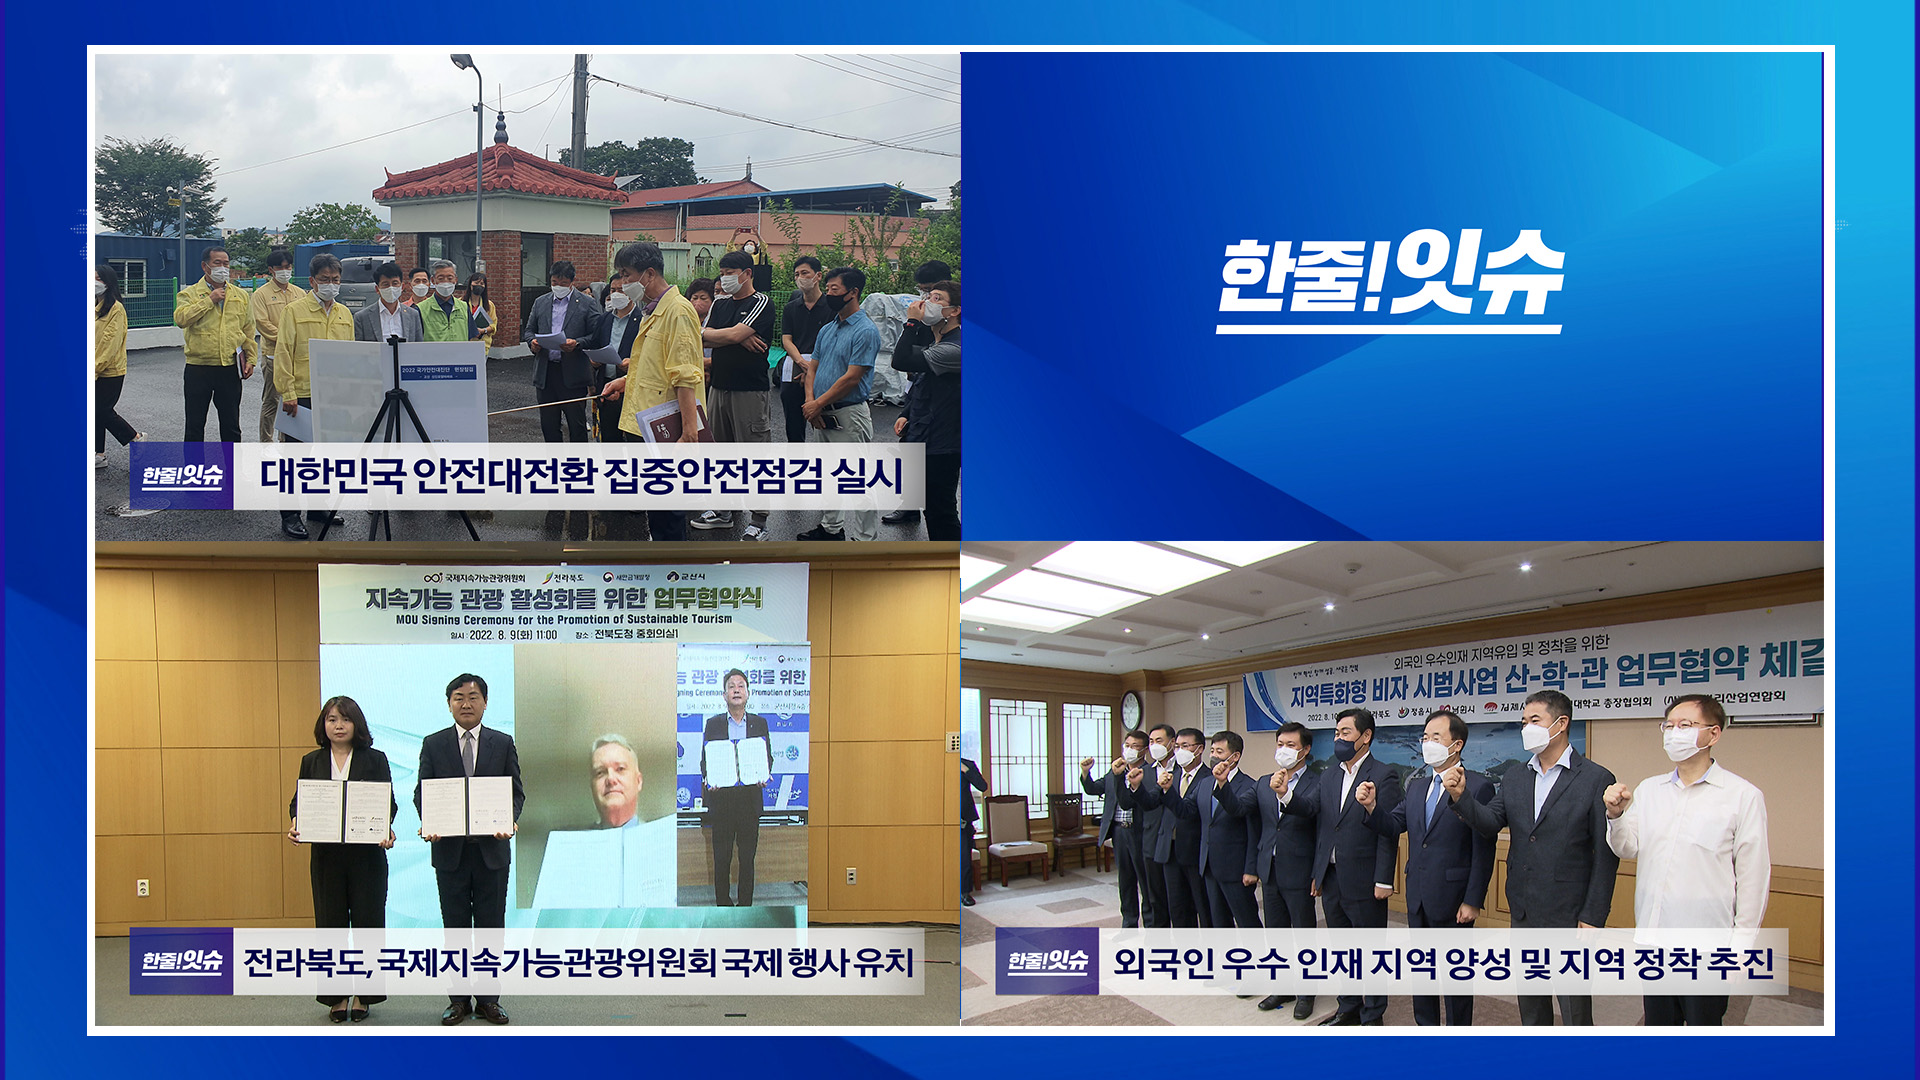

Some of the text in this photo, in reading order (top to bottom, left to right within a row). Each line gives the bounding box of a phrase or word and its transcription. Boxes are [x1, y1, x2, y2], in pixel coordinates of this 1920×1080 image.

[553, 573, 585, 583] 전라북도
[681, 573, 706, 581] 군산시
[366, 587, 763, 611] 지속가능 관광 활성화를 위한 업무협약식
[396, 613, 733, 626] MOU Signing Ceremony for the Promotion of Sustainable Tourism
[536, 630, 558, 640] 11:00
[594, 629, 634, 640] 전북도청
[636, 629, 679, 639] 중회의실1
[1394, 634, 1611, 670] 외국인 우수인재 지역유입 및 정착을 위한
[691, 669, 719, 685] 관광
[780, 669, 806, 685] 위한
[1291, 679, 1367, 708] 지역특화형
[1372, 675, 1409, 702] 비자
[1413, 666, 1498, 699] 시범사업
[1505, 656, 1609, 694] 산-학-관
[1616, 645, 1749, 687] 업무협약
[695, 688, 725, 696] Ceremon
[1713, 690, 1787, 704] 리산업연합회
[1603, 697, 1652, 709] 총장협의회
[1370, 710, 1391, 719] 라북도
[1410, 707, 1432, 716] 정읍시
